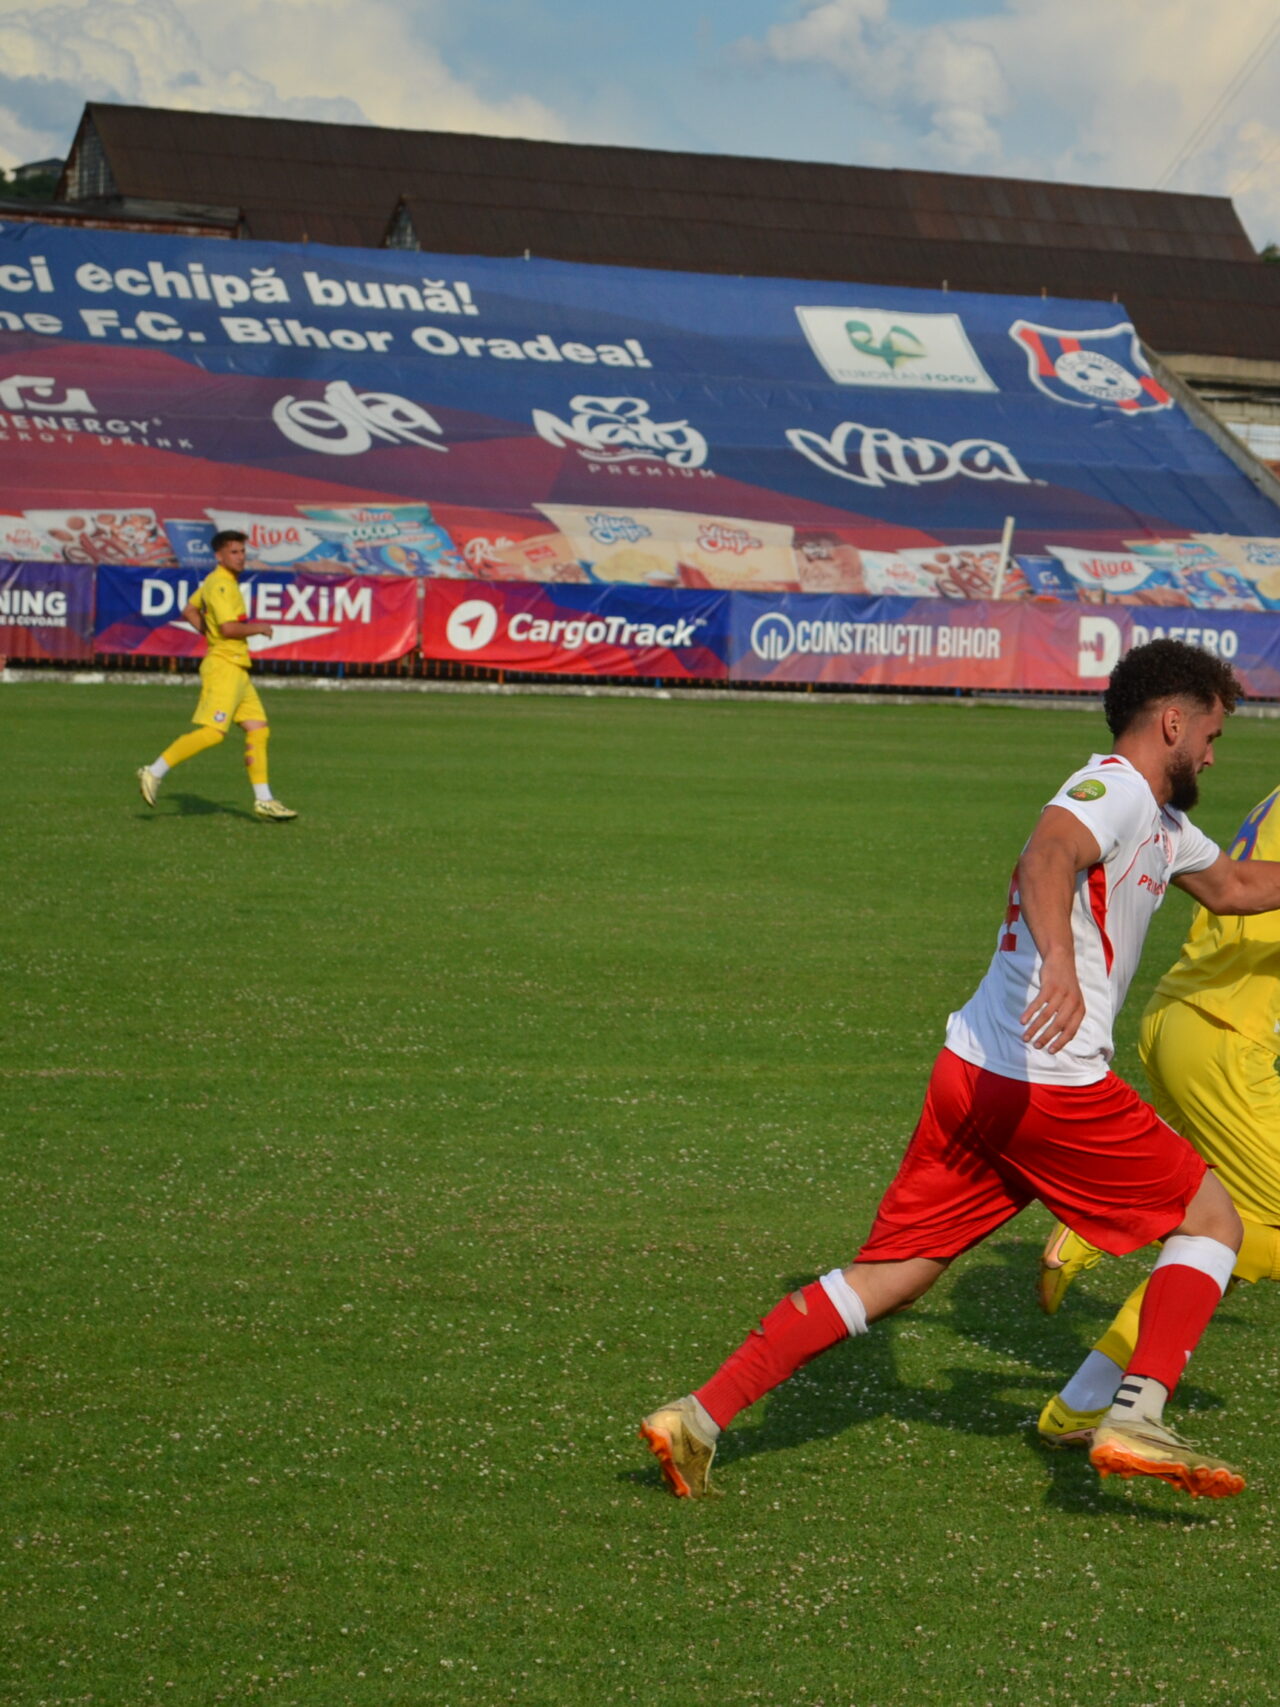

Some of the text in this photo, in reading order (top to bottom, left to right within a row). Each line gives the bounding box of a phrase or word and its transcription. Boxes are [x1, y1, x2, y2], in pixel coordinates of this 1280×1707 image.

[75, 261, 290, 309] echipă
[303, 271, 479, 316] bună!
[220, 316, 393, 352] Bihor
[411, 326, 653, 368] Oradea!
[937, 626, 1001, 659] BIHOR
